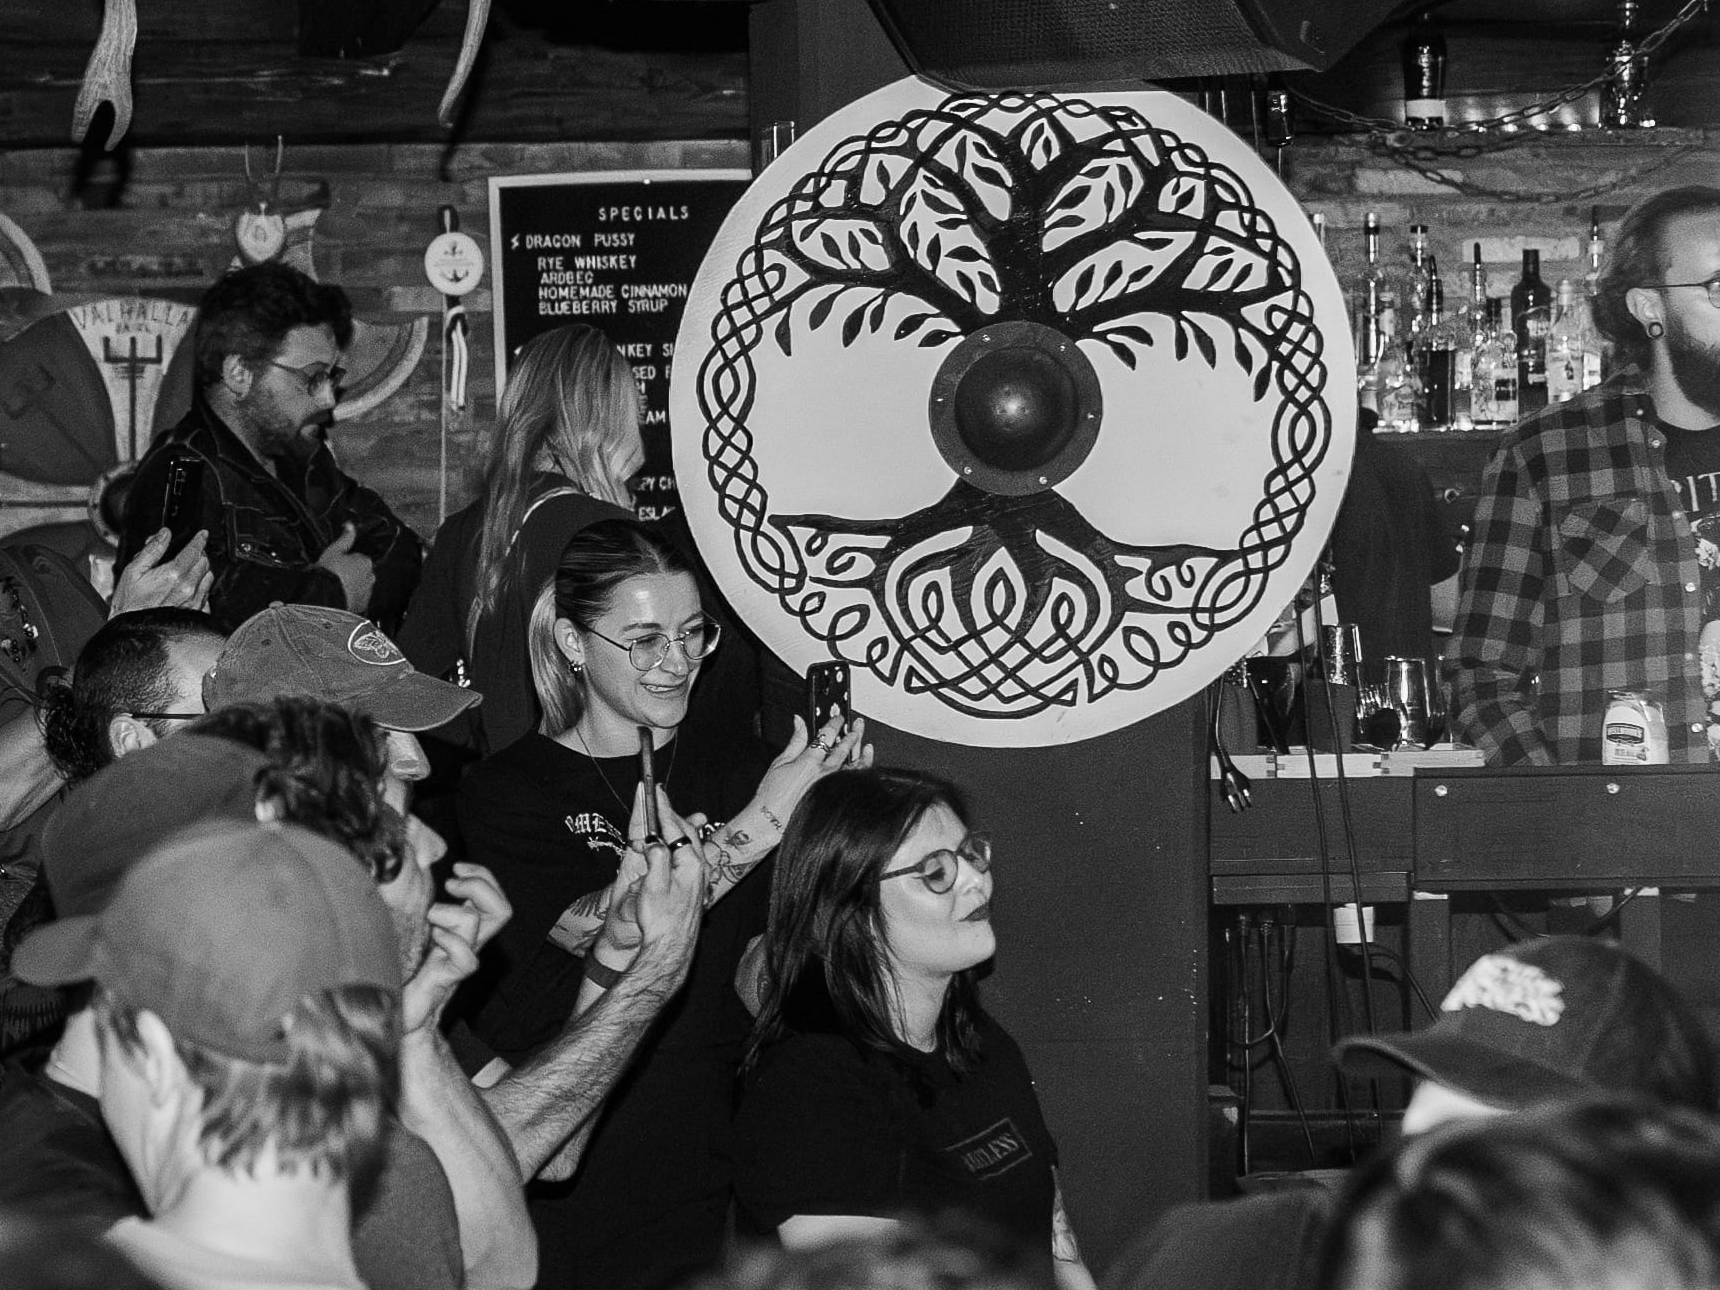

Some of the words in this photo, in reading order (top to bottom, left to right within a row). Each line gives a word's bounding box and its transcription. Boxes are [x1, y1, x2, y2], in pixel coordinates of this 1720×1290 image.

[598, 206, 689, 221] SPECIALS
[525, 234, 581, 249] DRAGON
[593, 232, 635, 248] PUSSY
[537, 256, 564, 271] RYE
[574, 254, 637, 269] WHISKEY
[538, 284, 615, 300] HOMEMADE
[621, 283, 688, 299] CINNAMON
[71, 300, 190, 330] VALHALLA
[538, 299, 618, 315] BLUEBERRY
[628, 298, 669, 313] SYRUP
